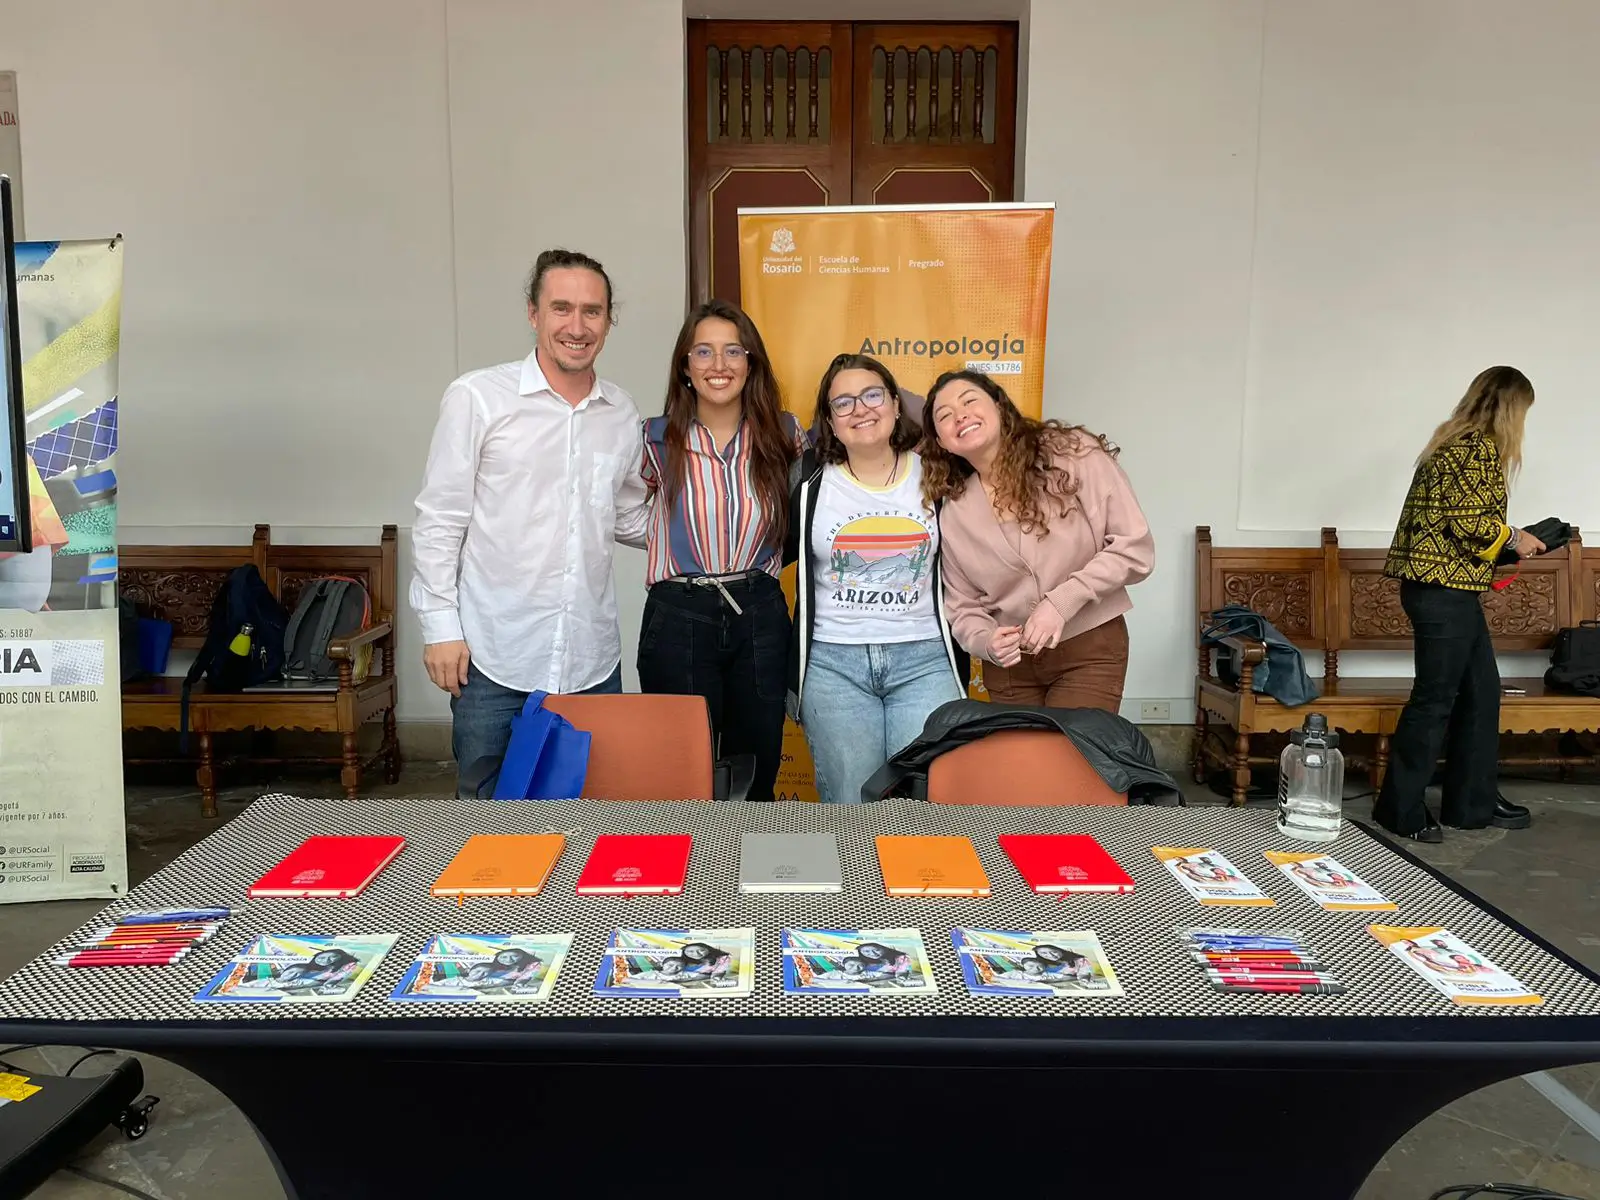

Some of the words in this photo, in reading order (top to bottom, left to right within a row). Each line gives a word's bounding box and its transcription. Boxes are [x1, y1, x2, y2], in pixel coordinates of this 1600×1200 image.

[819, 256, 845, 264] Escuela
[849, 256, 860, 264] de
[908, 259, 945, 270] Pregrado
[762, 262, 802, 273] Rosario
[819, 266, 851, 274] Ciencias
[853, 265, 890, 273] Humanas
[859, 334, 1024, 360] Antropología
[995, 363, 1021, 372] 51786
[826, 522, 843, 542] THE
[848, 510, 900, 521] DESERT
[832, 588, 919, 605] ARIZONA
[10, 628, 34, 638] 51887
[0, 648, 42, 673] IA
[22, 692, 41, 704] CON
[45, 691, 56, 703] EL
[59, 690, 99, 703] CAMBIO.
[28, 813, 40, 822] por
[48, 812, 68, 820] años.
[8, 845, 50, 854] @URSocial
[8, 861, 53, 870] @URFamily
[8, 875, 50, 883] @URSocial
